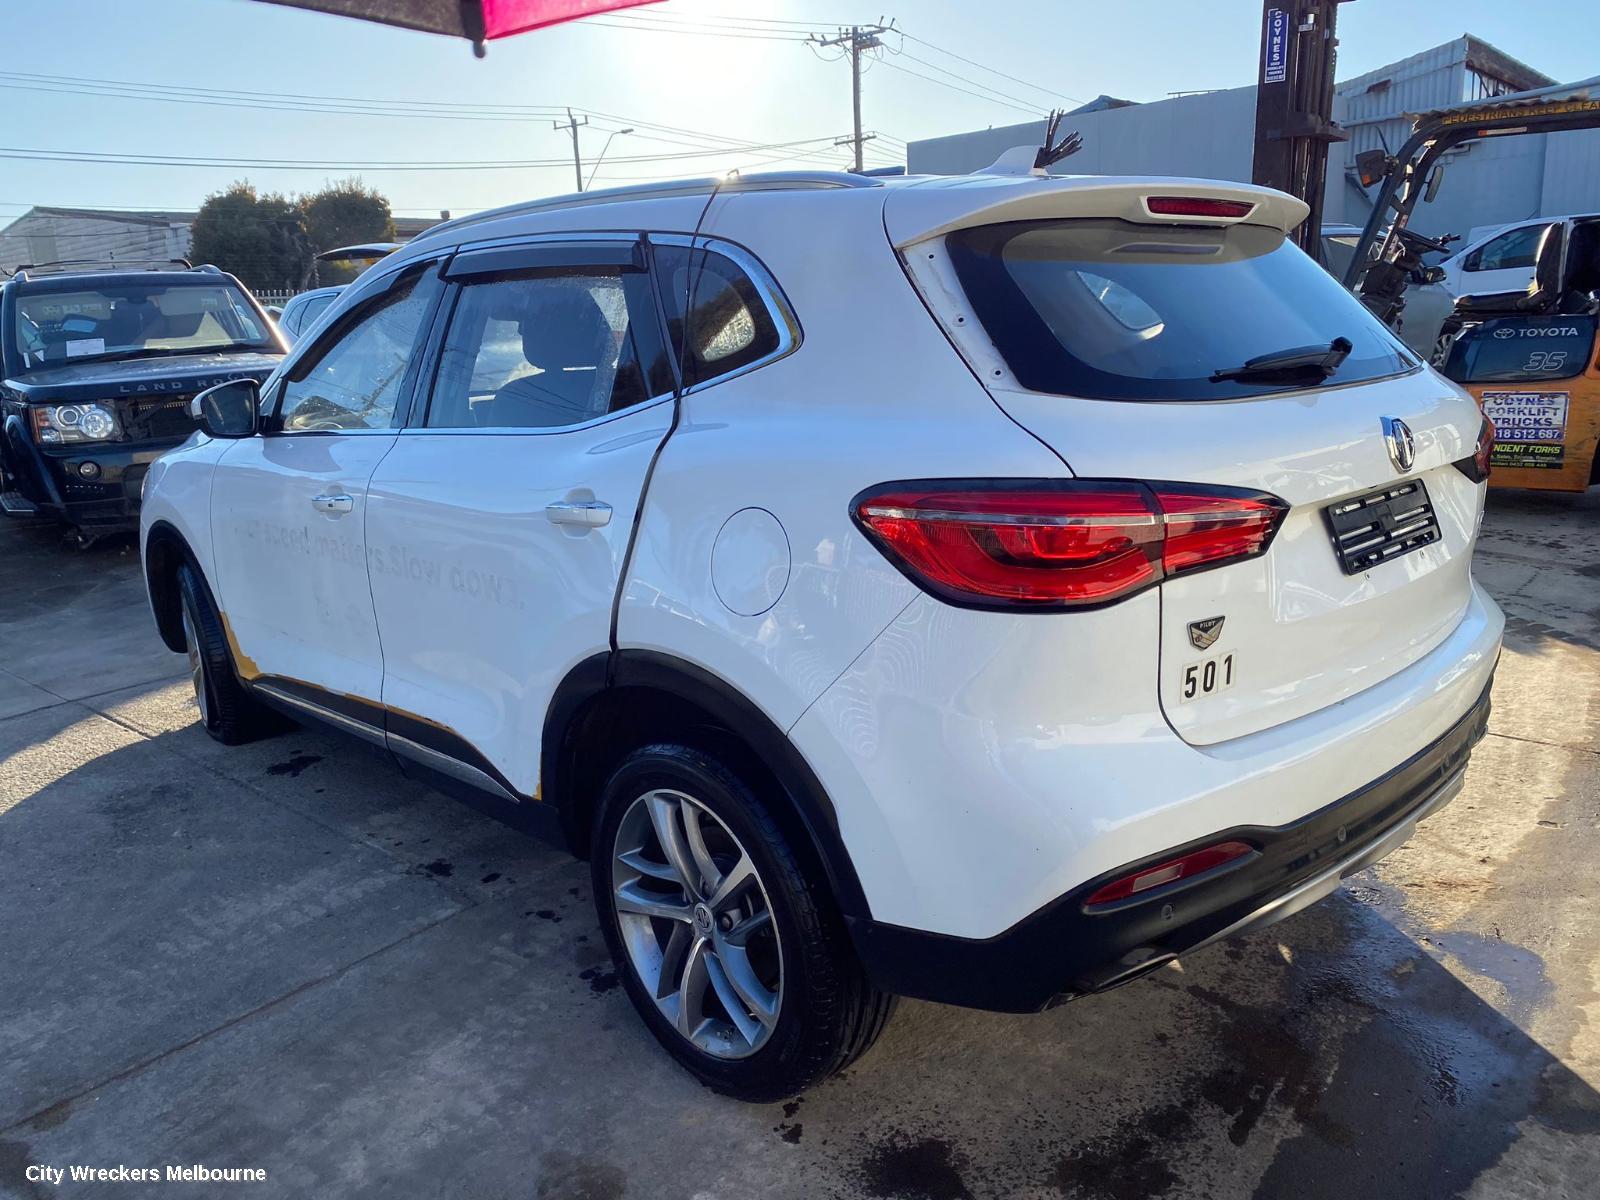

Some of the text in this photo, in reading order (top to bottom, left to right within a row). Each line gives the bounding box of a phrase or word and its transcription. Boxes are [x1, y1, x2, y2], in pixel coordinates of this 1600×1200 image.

[1565, 101, 1600, 112] CLEA
[1519, 327, 1578, 337] TOYOTA
[1523, 351, 1568, 371] 35
[119, 380, 182, 393] LAND
[1493, 397, 1556, 406] COYNES
[1487, 407, 1561, 417] FORKLIFT
[1493, 417, 1553, 427] TRUCKS
[1514, 429, 1536, 439] 512
[1538, 429, 1560, 439] 687
[1529, 445, 1561, 454] FORKS
[1199, 619, 1216, 629] PILOT
[1184, 654, 1233, 699] 501
